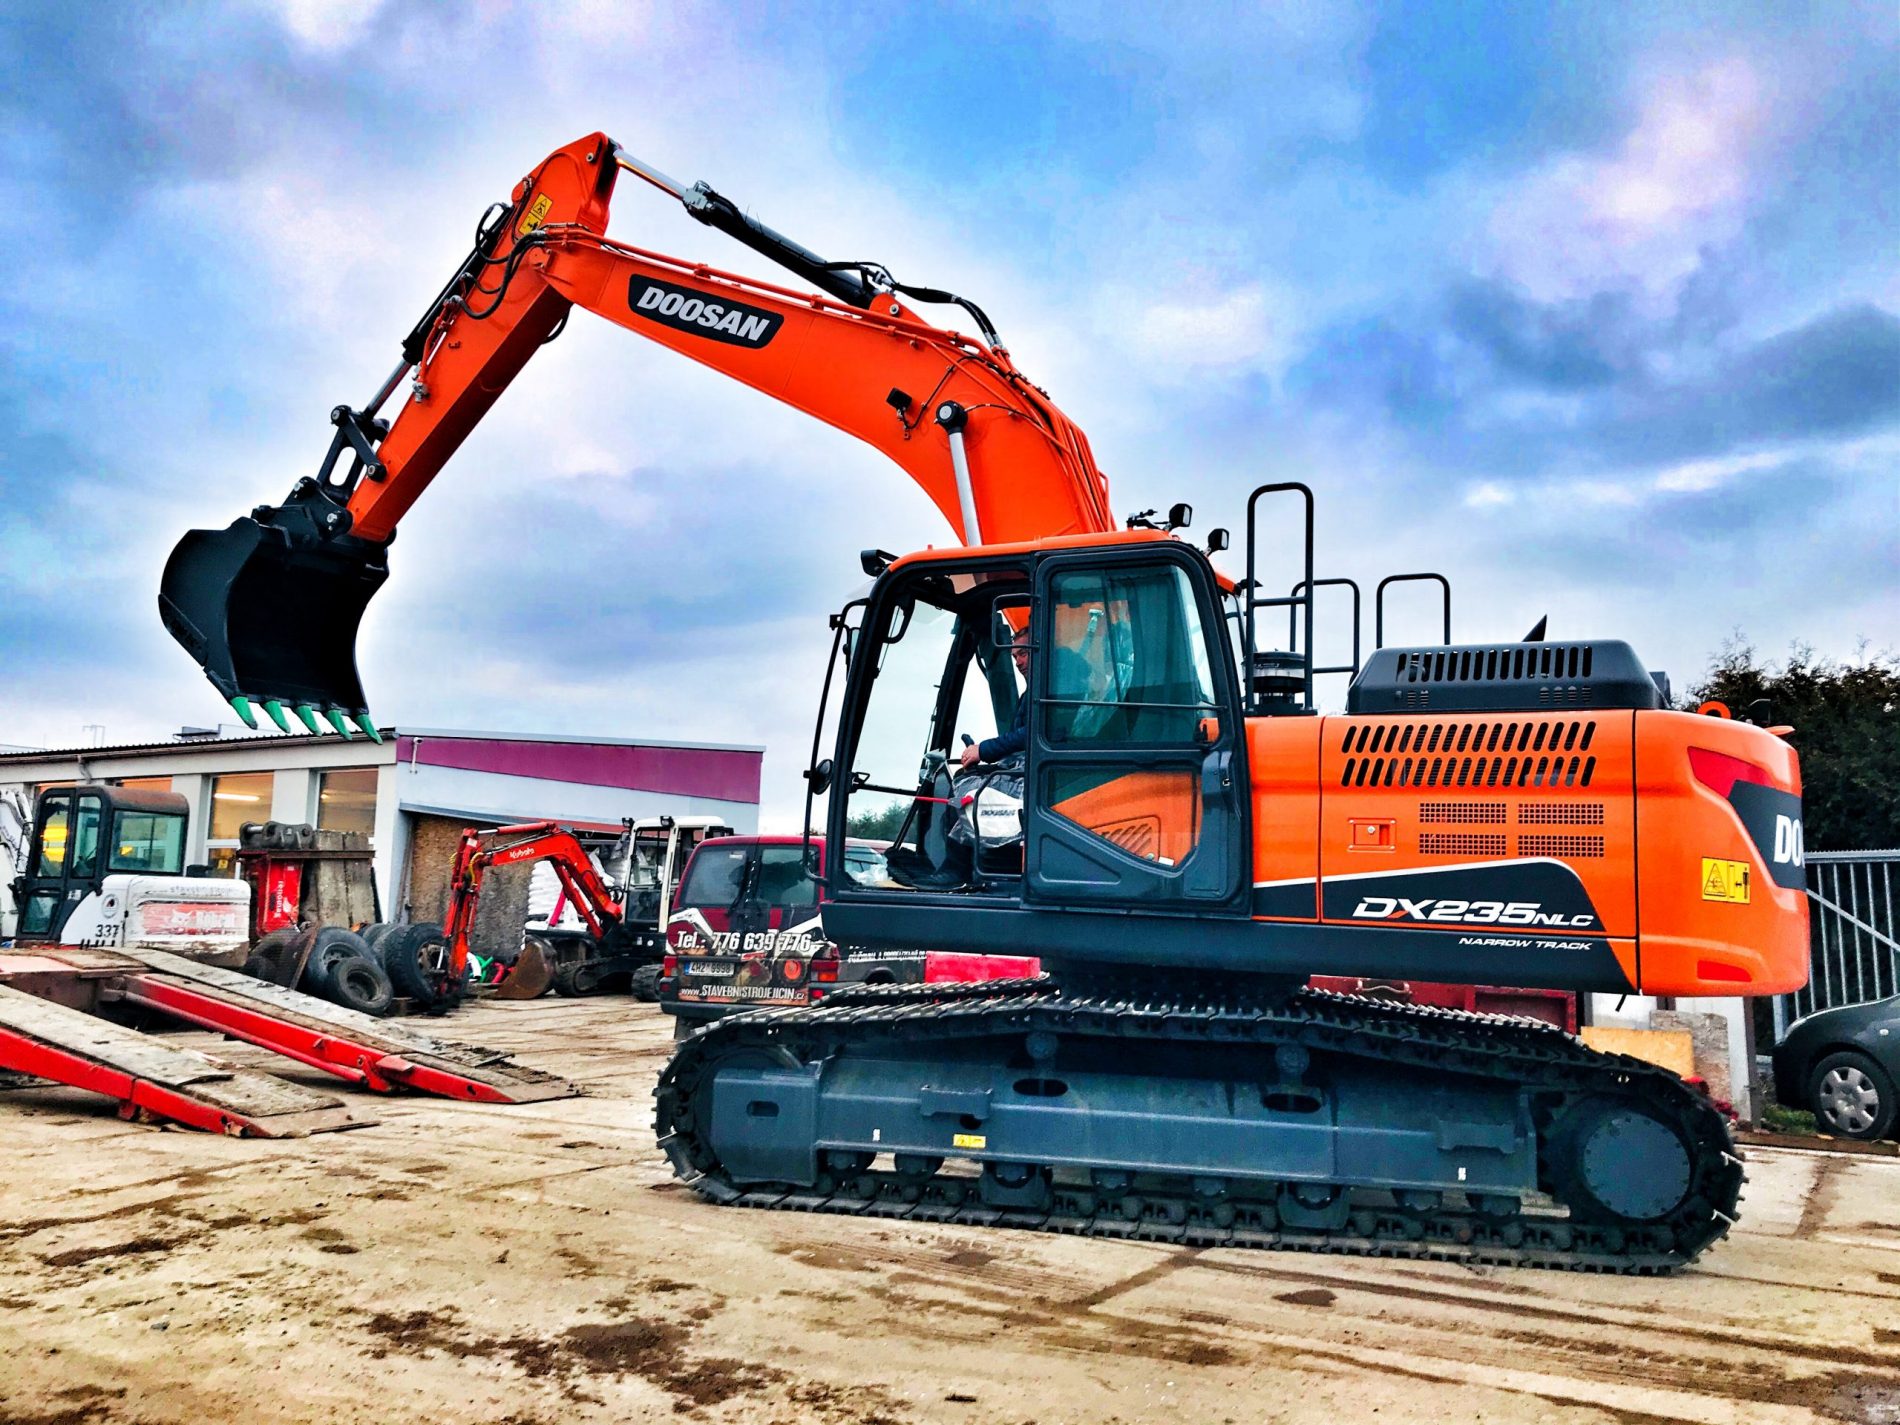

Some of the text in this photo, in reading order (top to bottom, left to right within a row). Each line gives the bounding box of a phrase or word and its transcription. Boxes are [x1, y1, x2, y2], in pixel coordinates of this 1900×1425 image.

[637, 286, 770, 342] DOOSAN
[1773, 814, 1806, 869] DO
[95, 924, 119, 938] 337
[677, 931, 812, 952] Tel.: 776 639 776
[1458, 938, 1593, 950] NARROW TRACK
